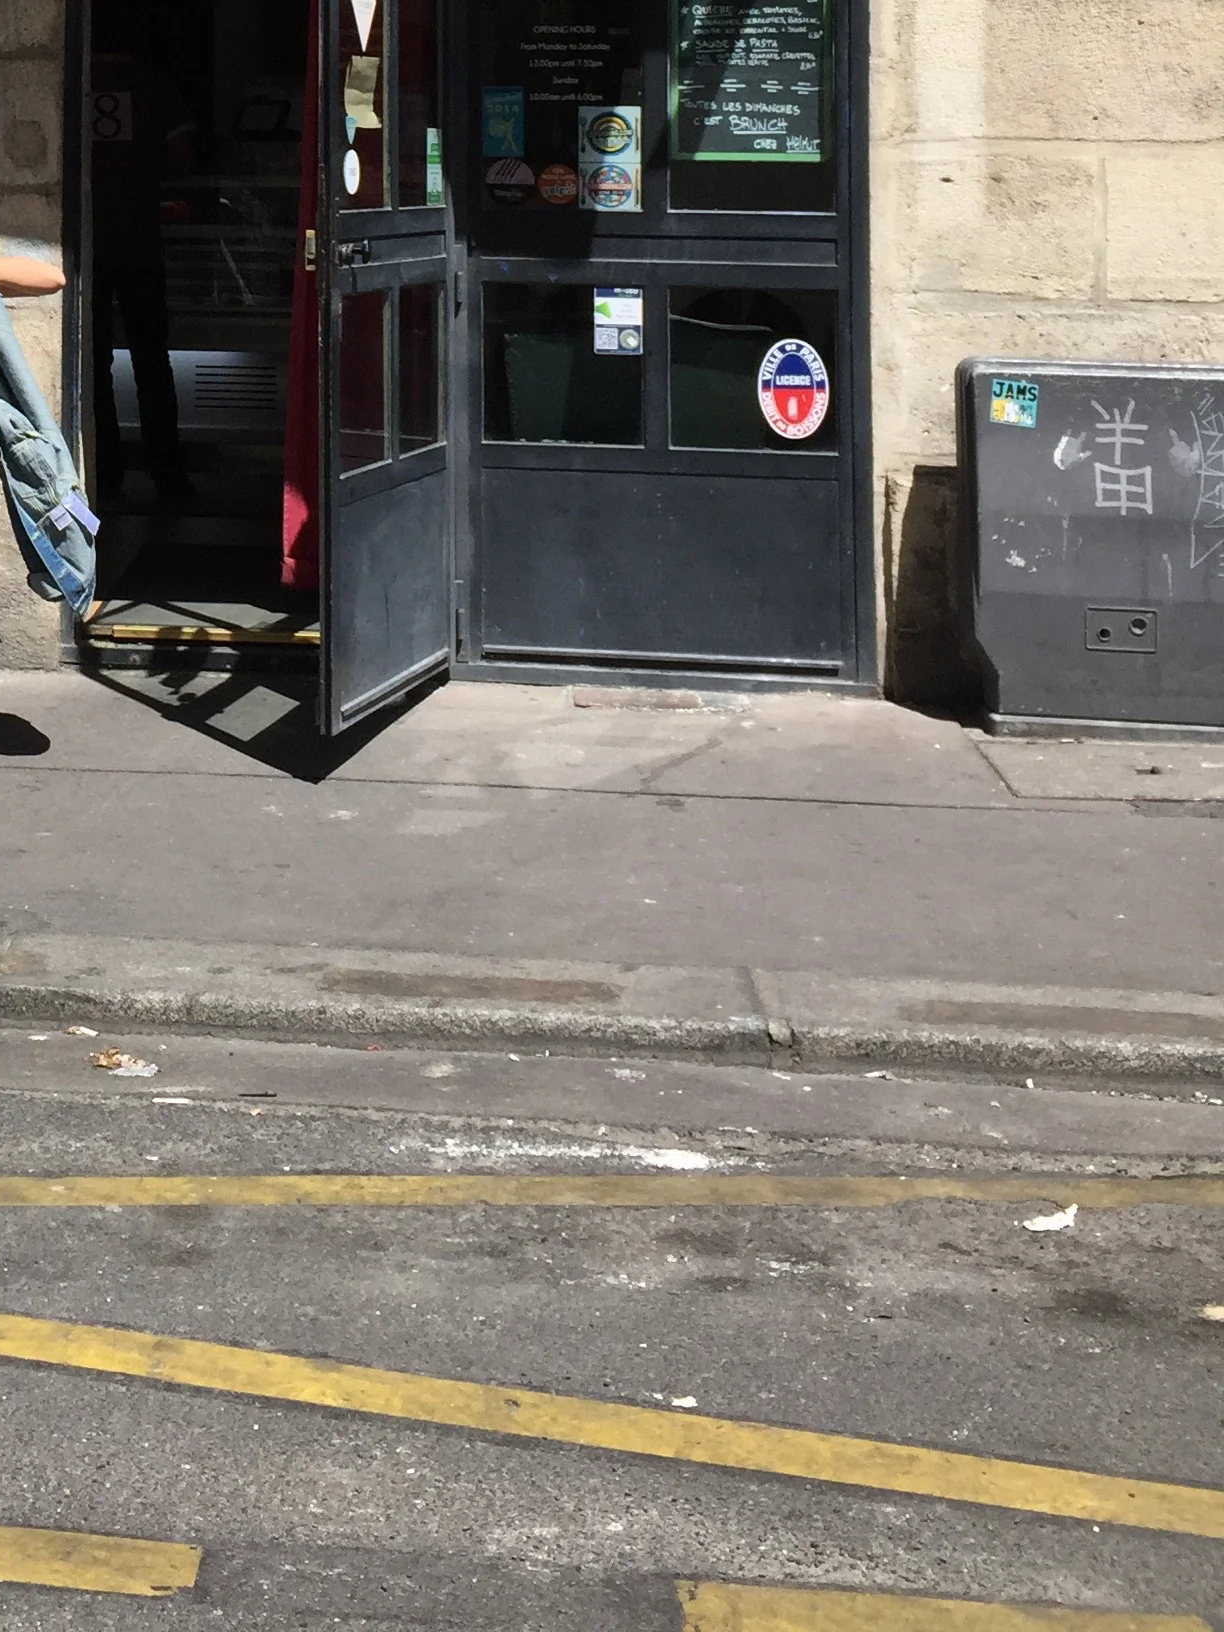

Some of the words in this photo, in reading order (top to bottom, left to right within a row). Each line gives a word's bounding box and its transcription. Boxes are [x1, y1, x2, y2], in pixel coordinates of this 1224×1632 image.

[749, 37, 778, 48] PASTA
[722, 101, 742, 112] LES
[745, 101, 801, 116] DIMANCHES
[729, 115, 789, 131] BRUNCH
[762, 349, 784, 380] VILLE
[799, 347, 825, 382] PARIS
[775, 375, 812, 386] LICENCE
[993, 381, 1038, 403] JAMS
